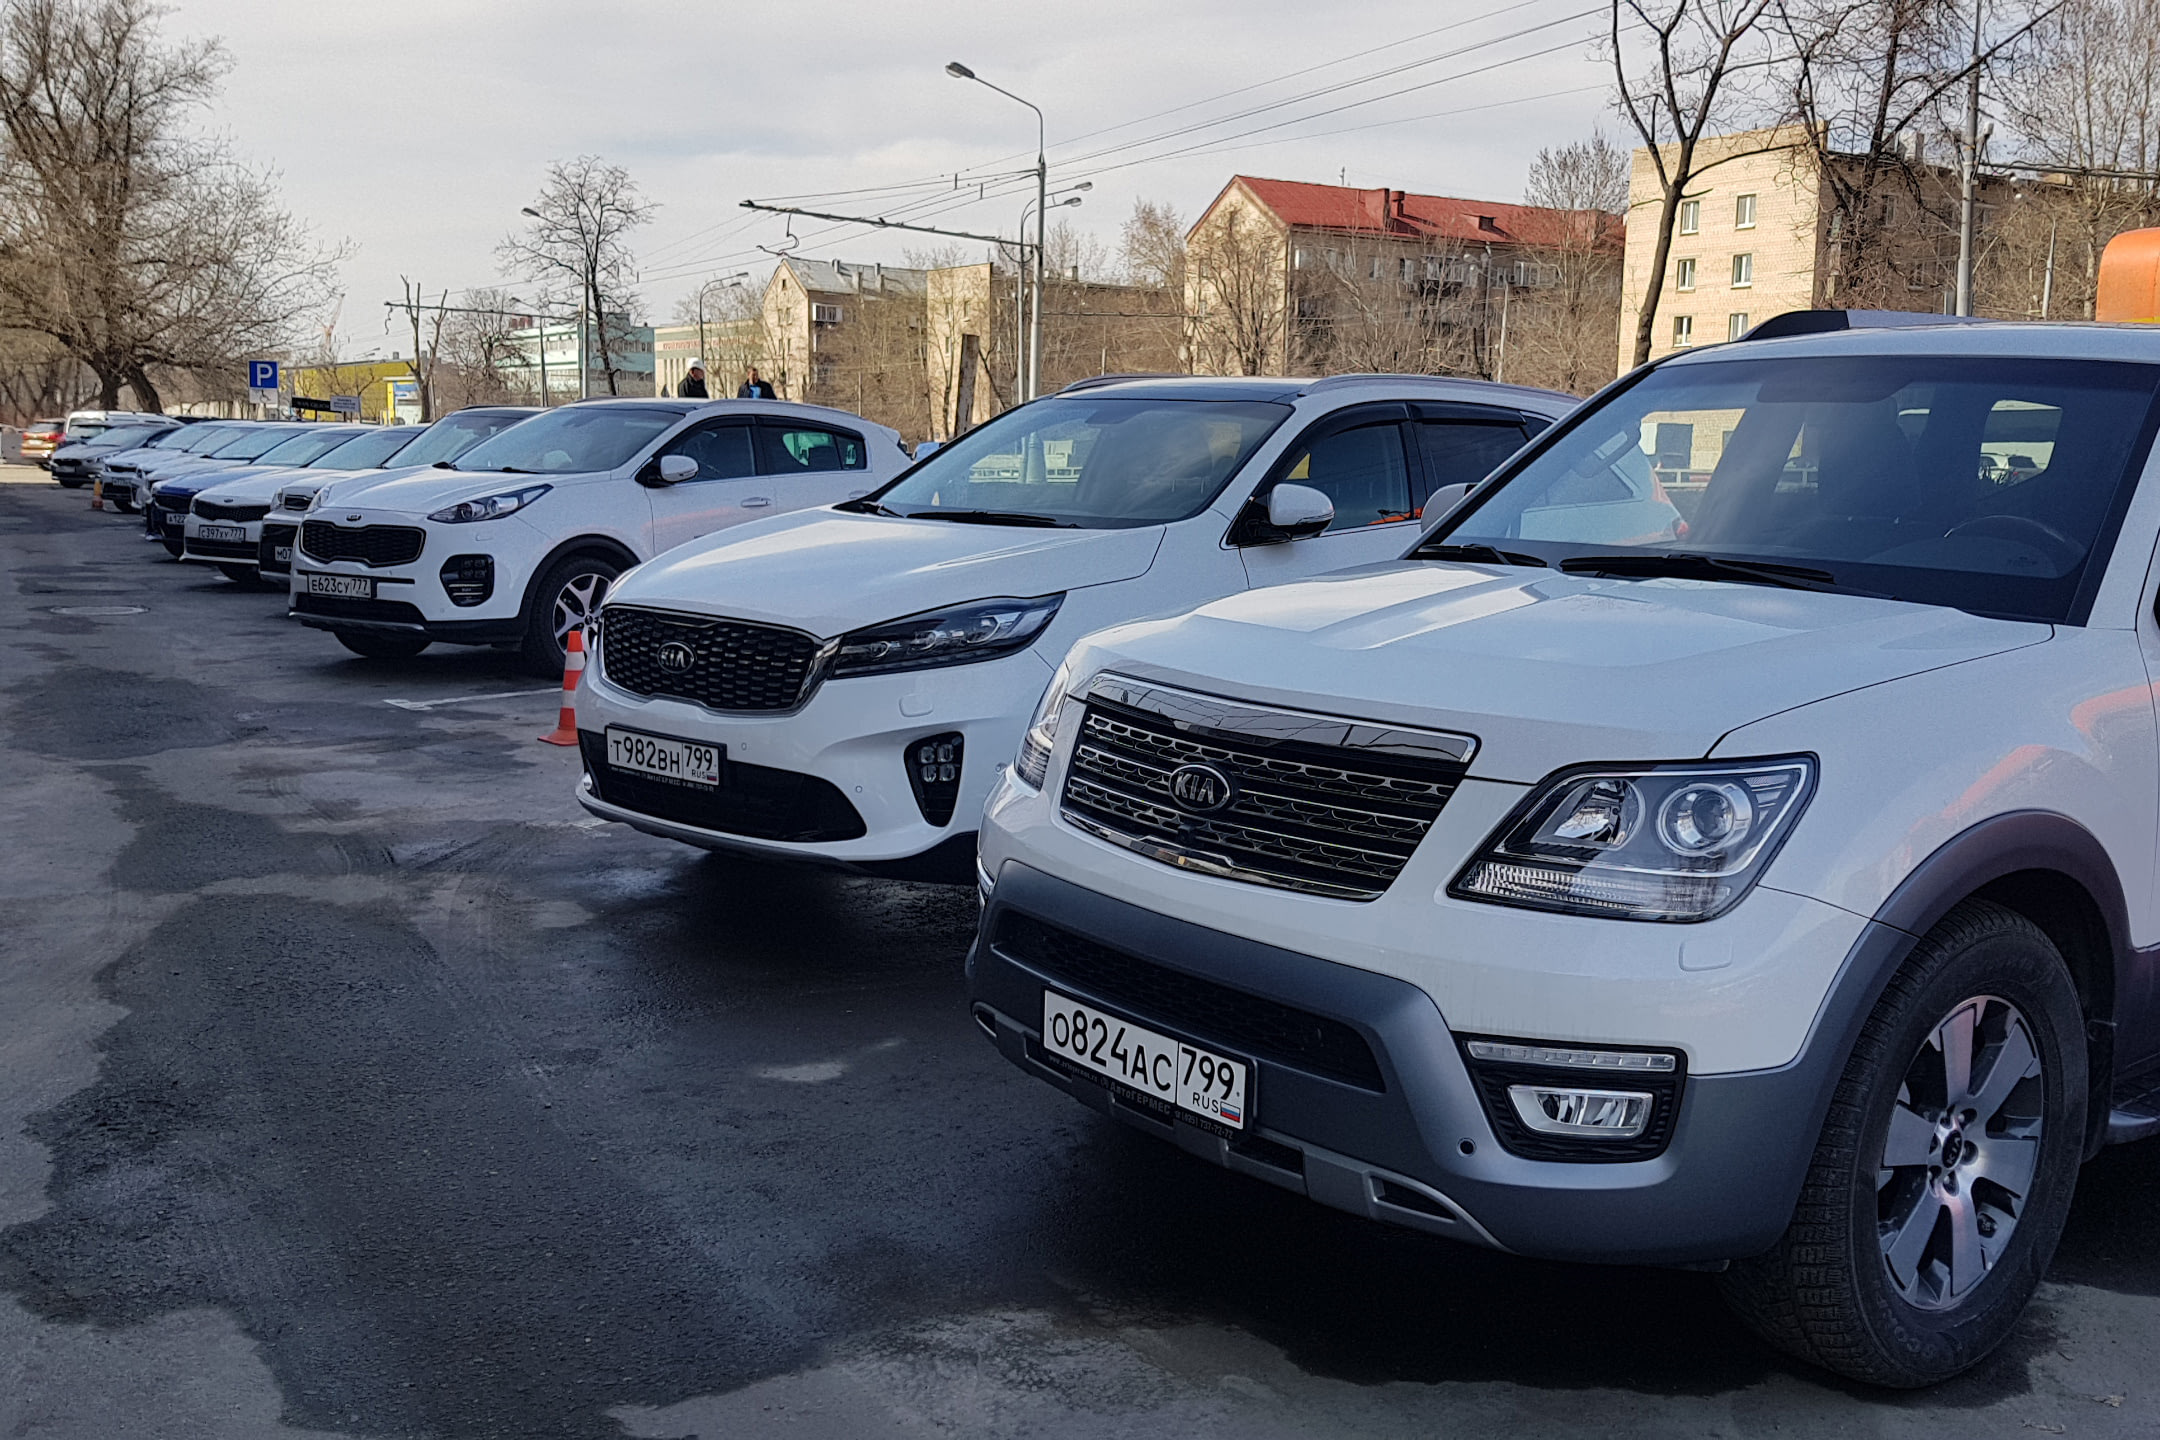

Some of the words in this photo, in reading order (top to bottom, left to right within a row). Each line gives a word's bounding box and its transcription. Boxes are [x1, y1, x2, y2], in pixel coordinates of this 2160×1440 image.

[257, 363, 273, 387] P
[277, 548, 292, 560] М07
[661, 649, 686, 668] KIA
[684, 745, 713, 771] 799
[691, 768, 707, 780] RUS
[1175, 771, 1215, 804] KIA
[1180, 1046, 1235, 1101] 799
[1192, 1091, 1219, 1114] RUS
